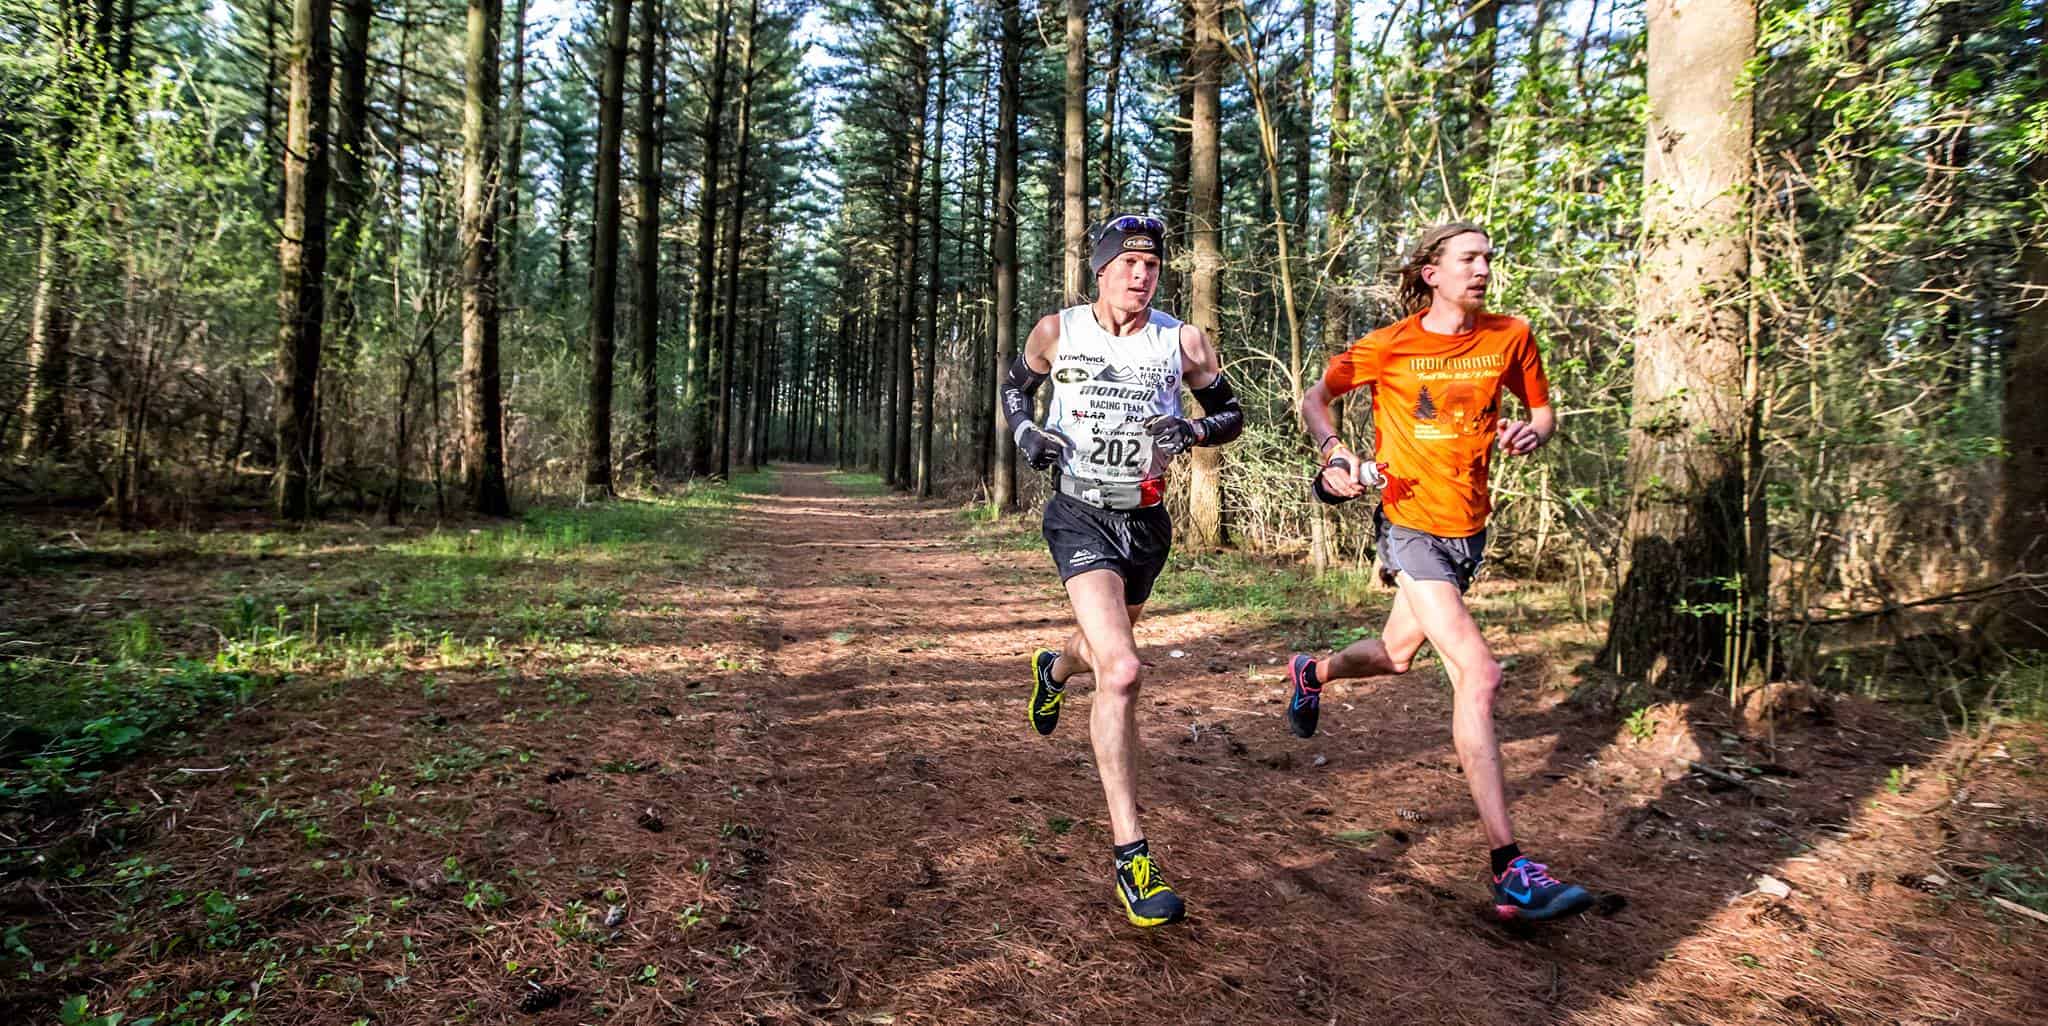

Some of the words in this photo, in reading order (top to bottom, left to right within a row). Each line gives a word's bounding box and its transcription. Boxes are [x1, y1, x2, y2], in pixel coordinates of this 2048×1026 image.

[1079, 385, 1156, 402] montrail
[1090, 399, 1120, 410] RACING
[1122, 402, 1144, 413] TEAM
[1125, 415, 1147, 423] RU
[1090, 437, 1141, 467] 202
